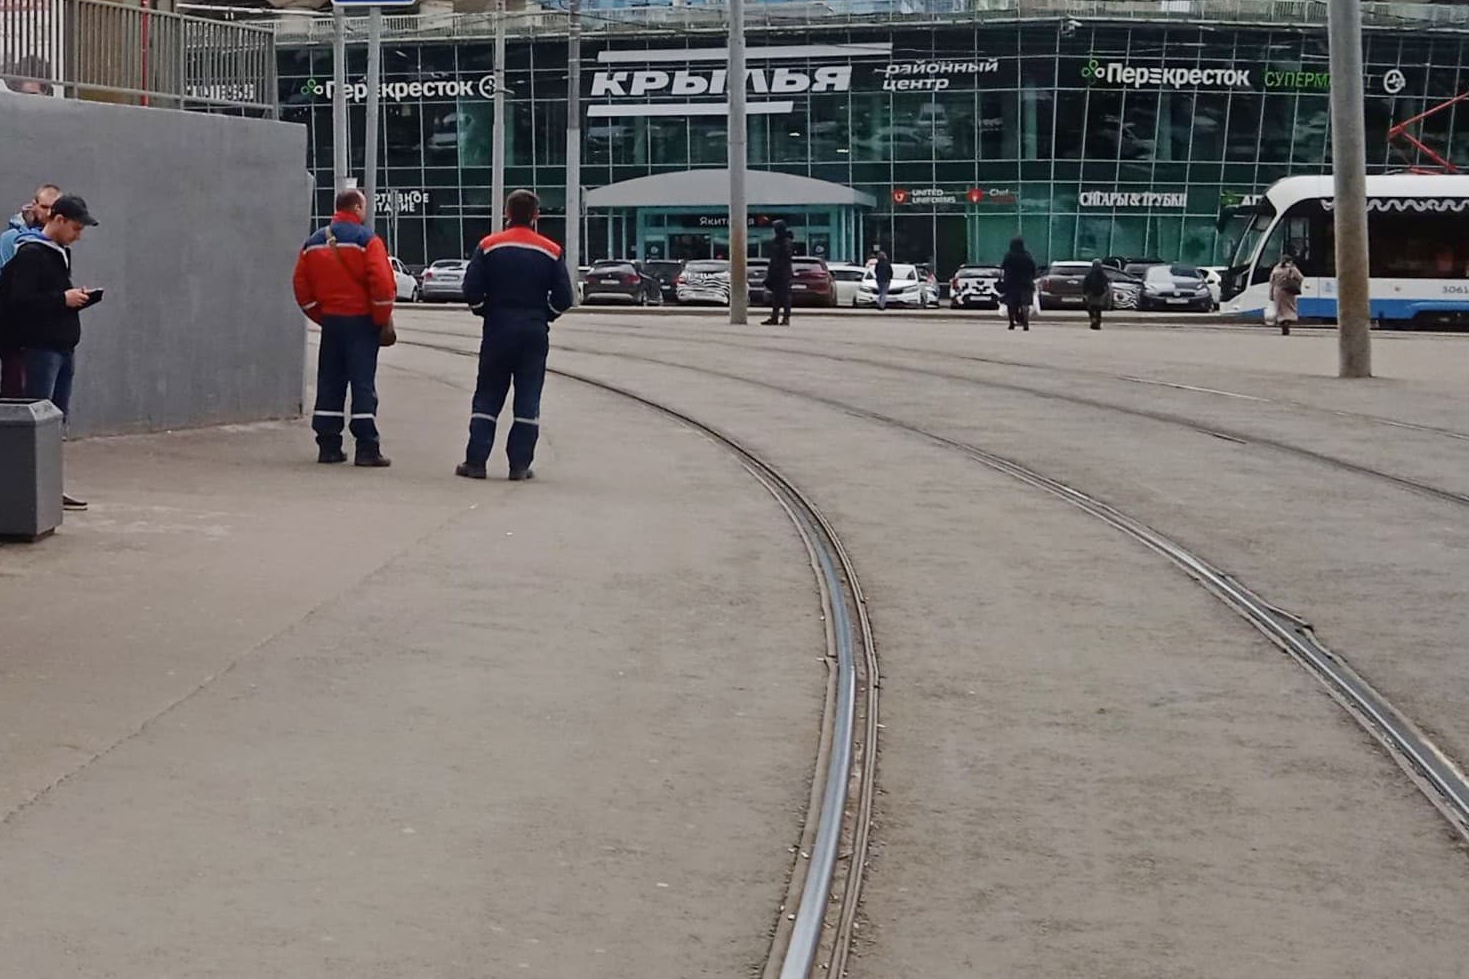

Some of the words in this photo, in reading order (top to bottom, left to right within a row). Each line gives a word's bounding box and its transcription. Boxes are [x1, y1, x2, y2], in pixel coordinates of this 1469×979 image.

[884, 58, 999, 78] районный
[1106, 62, 1251, 89] Перекресток
[590, 65, 852, 96] КРЫЛЬЯ
[882, 77, 950, 92] центр
[325, 79, 474, 103] Перкресток
[911, 188, 944, 196] UNITED
[911, 196, 957, 205] UNIFORMS
